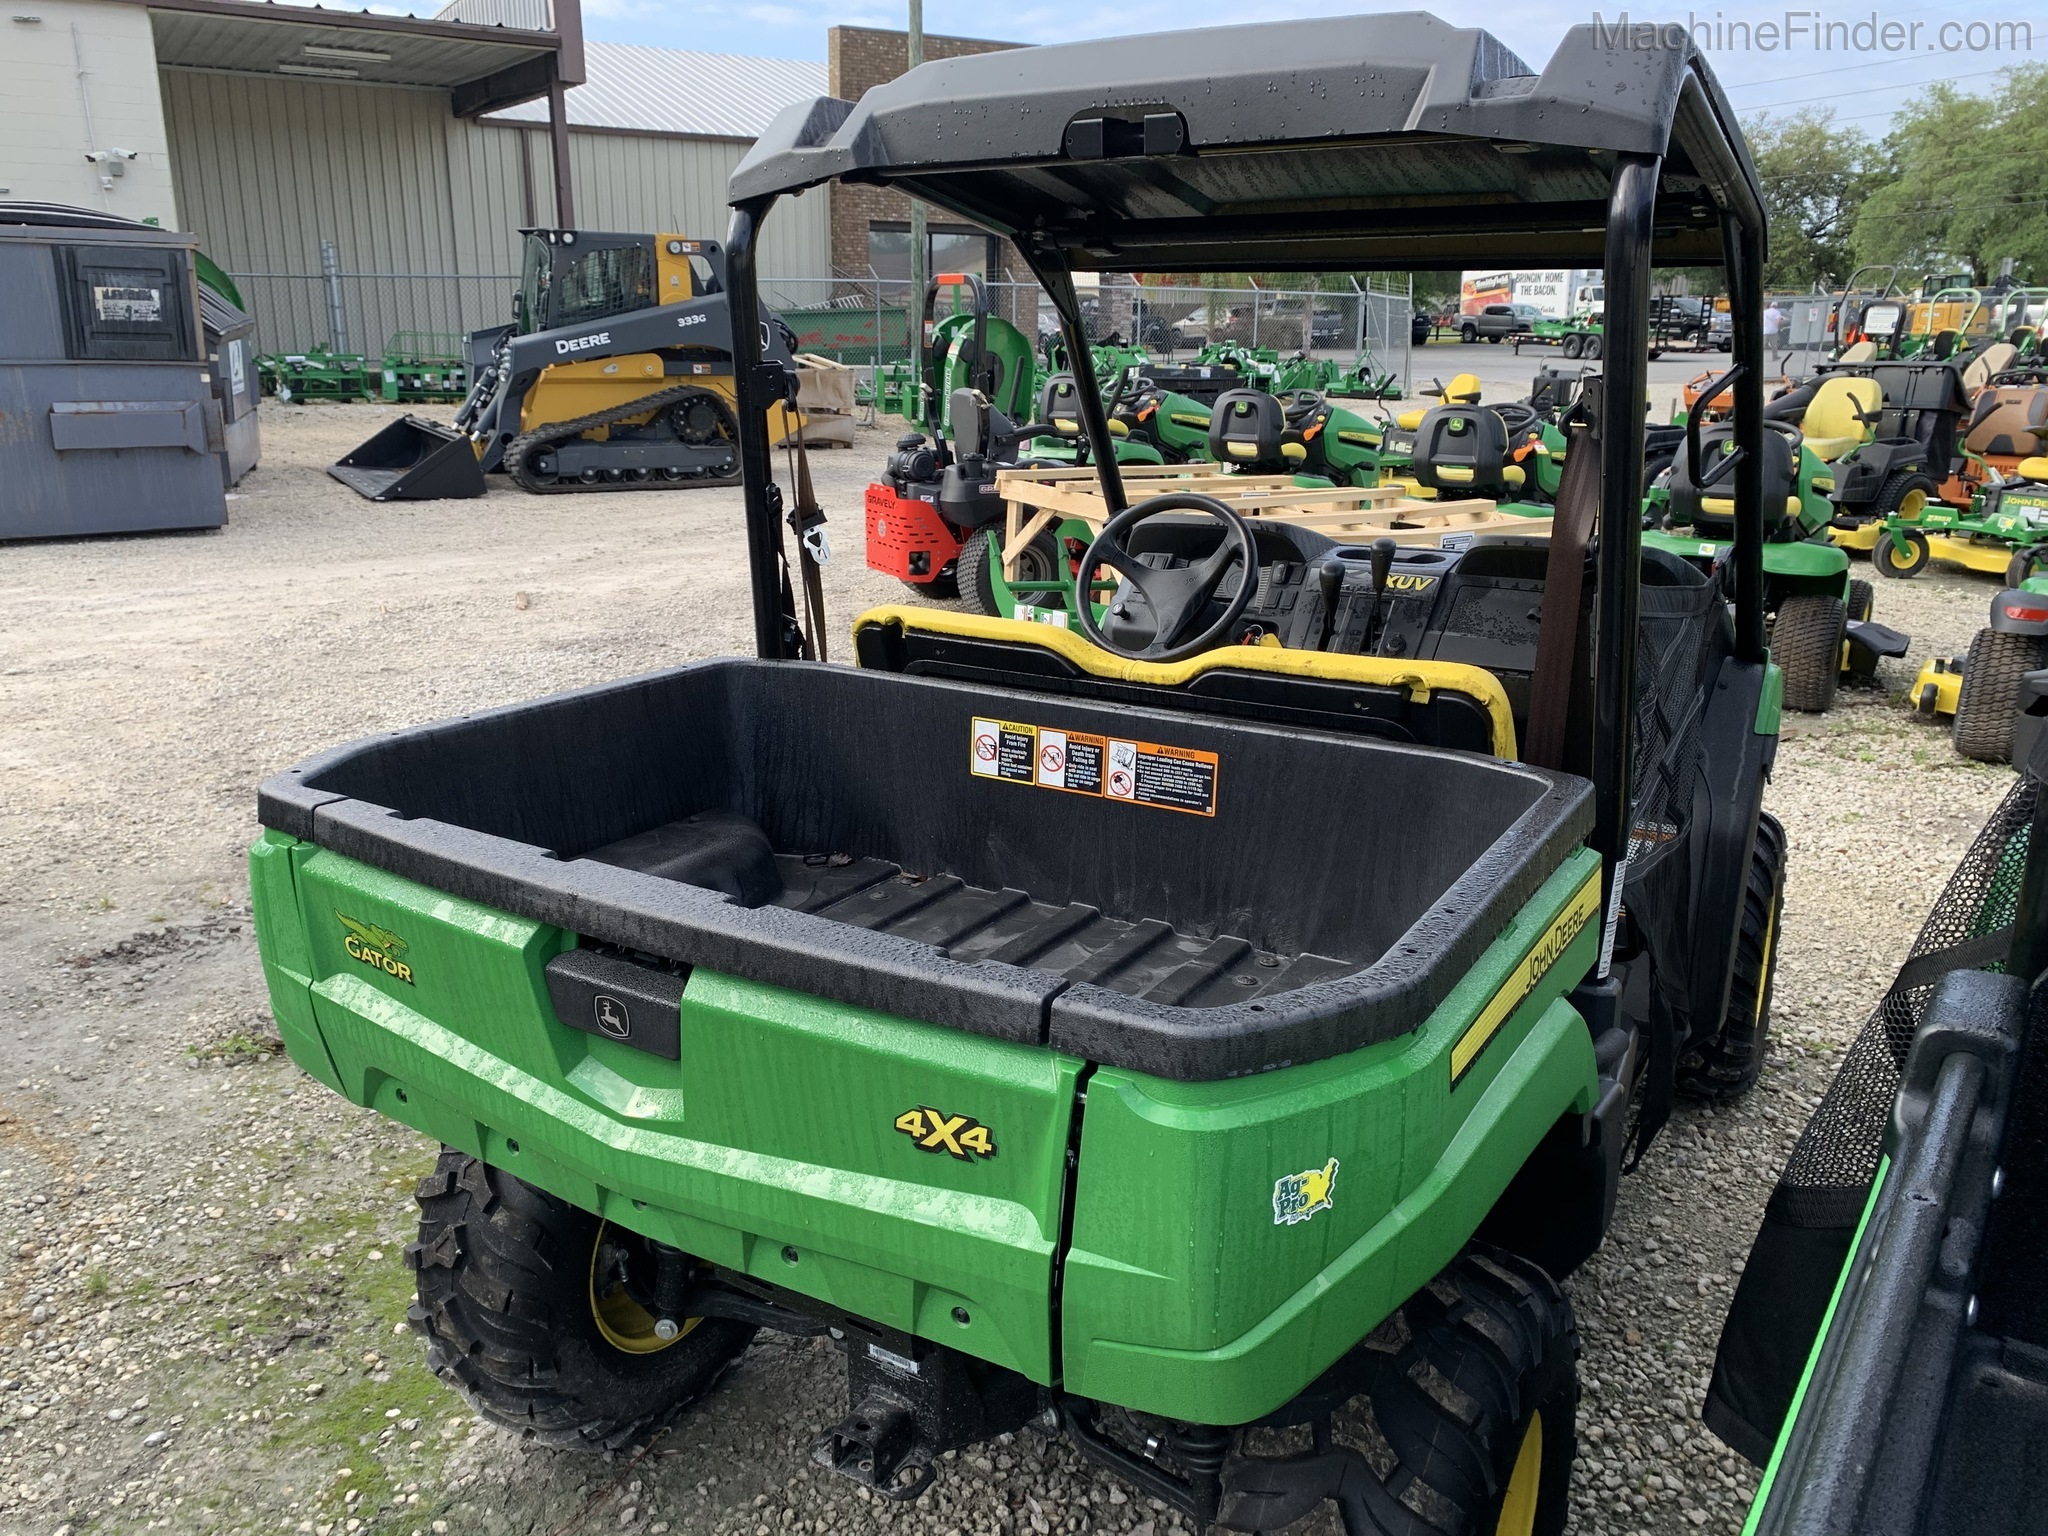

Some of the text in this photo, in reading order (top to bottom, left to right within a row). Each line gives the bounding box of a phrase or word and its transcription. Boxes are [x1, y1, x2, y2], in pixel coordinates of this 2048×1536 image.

[1545, 272, 1564, 283] HOME
[1521, 284, 1532, 296] THE
[676, 313, 707, 328] 333G
[555, 332, 612, 355] DEERE
[867, 494, 896, 510] GRAVELY
[2003, 496, 2032, 506] JOHN
[1009, 724, 1033, 734] CAUTION
[1075, 734, 1103, 745] WARNING
[1069, 743, 1081, 751] Avoid
[1082, 745, 1094, 753] Injury
[1164, 747, 1195, 759] WARNING
[1157, 756, 1173, 764] Loading
[1526, 902, 1585, 990] JOHN DEERE
[344, 934, 414, 985] GATOR
[895, 1107, 995, 1158] 4X4
[1278, 1193, 1309, 1218] Pro
